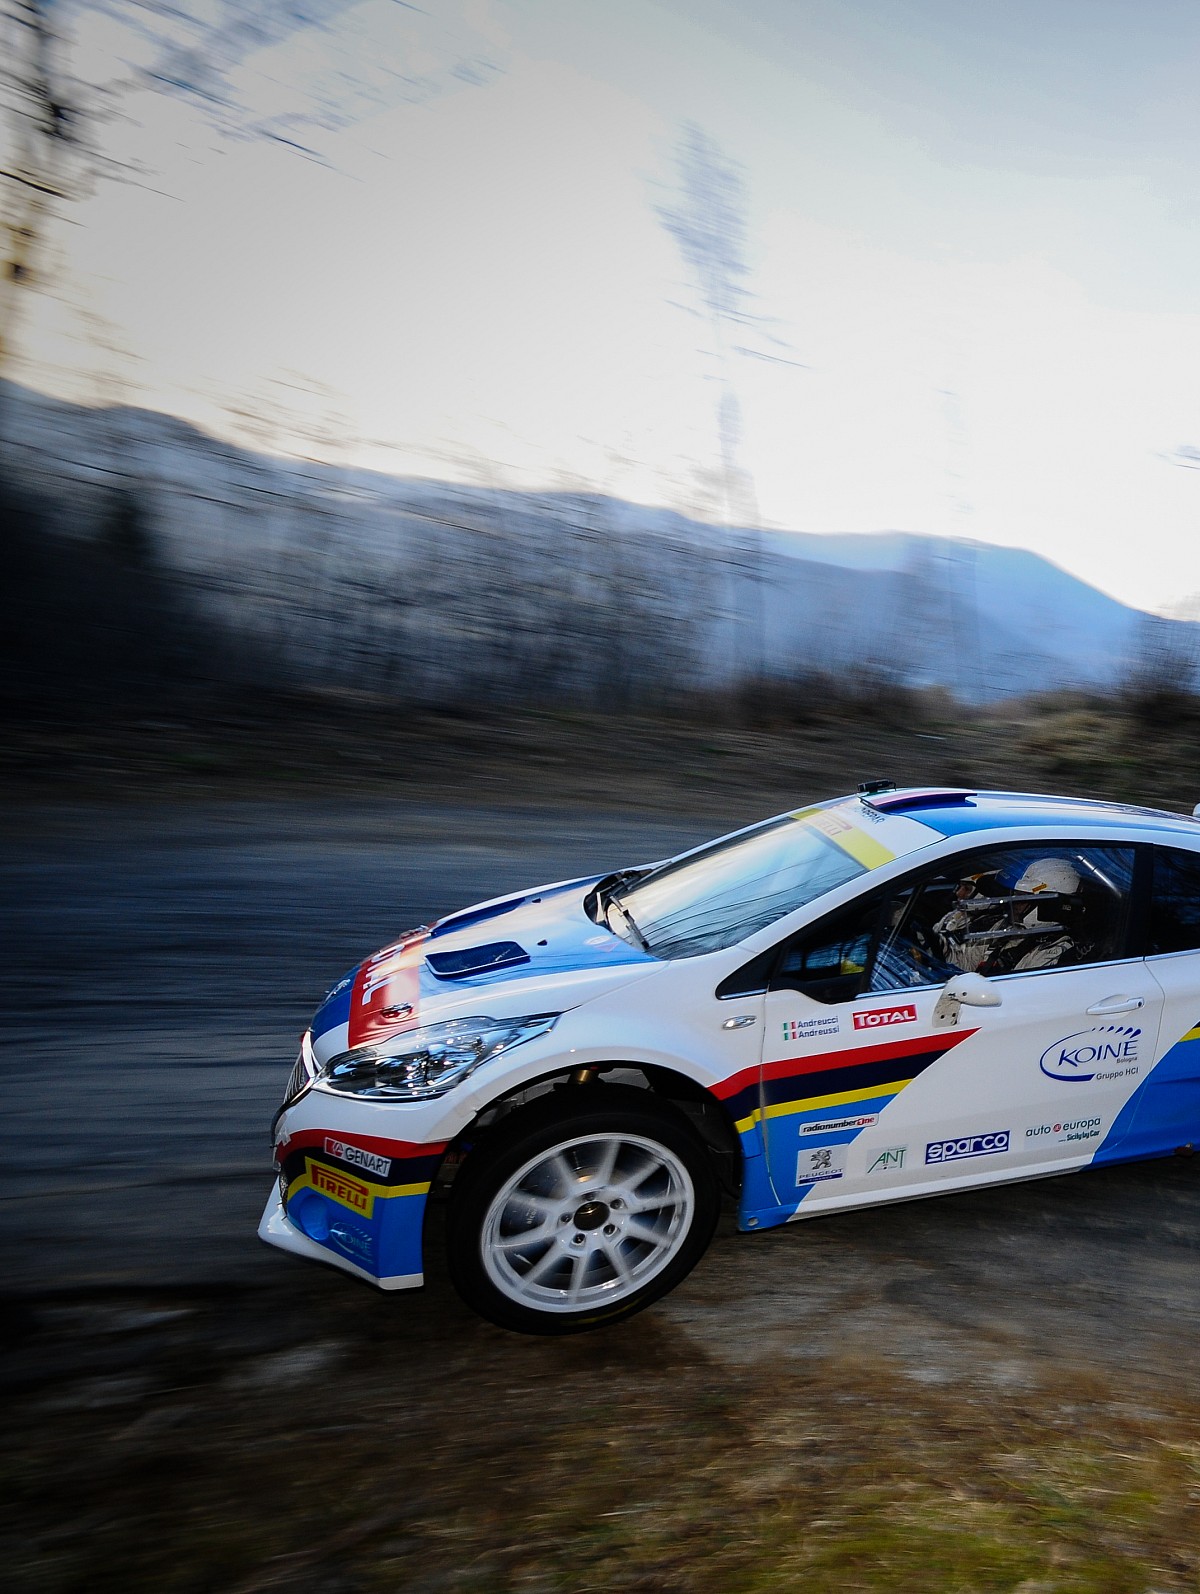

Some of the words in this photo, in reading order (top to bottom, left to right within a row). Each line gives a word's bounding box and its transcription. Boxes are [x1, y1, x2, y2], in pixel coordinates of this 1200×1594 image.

[797, 1015, 839, 1029] Andreucci
[854, 1010, 916, 1027] TOTAL
[798, 1026, 840, 1039] Andreussi
[1058, 1040, 1138, 1067] KOINE
[1116, 1056, 1138, 1065] Bologna
[1096, 1070, 1124, 1081] Gruppo
[1025, 1125, 1052, 1137] auto
[1062, 1117, 1101, 1131] europa
[1066, 1132, 1083, 1141] Sicily
[1089, 1129, 1101, 1137] Car
[927, 1133, 1008, 1162] sparco
[345, 1147, 389, 1175] GENART
[310, 1164, 369, 1210] PIRELLI
